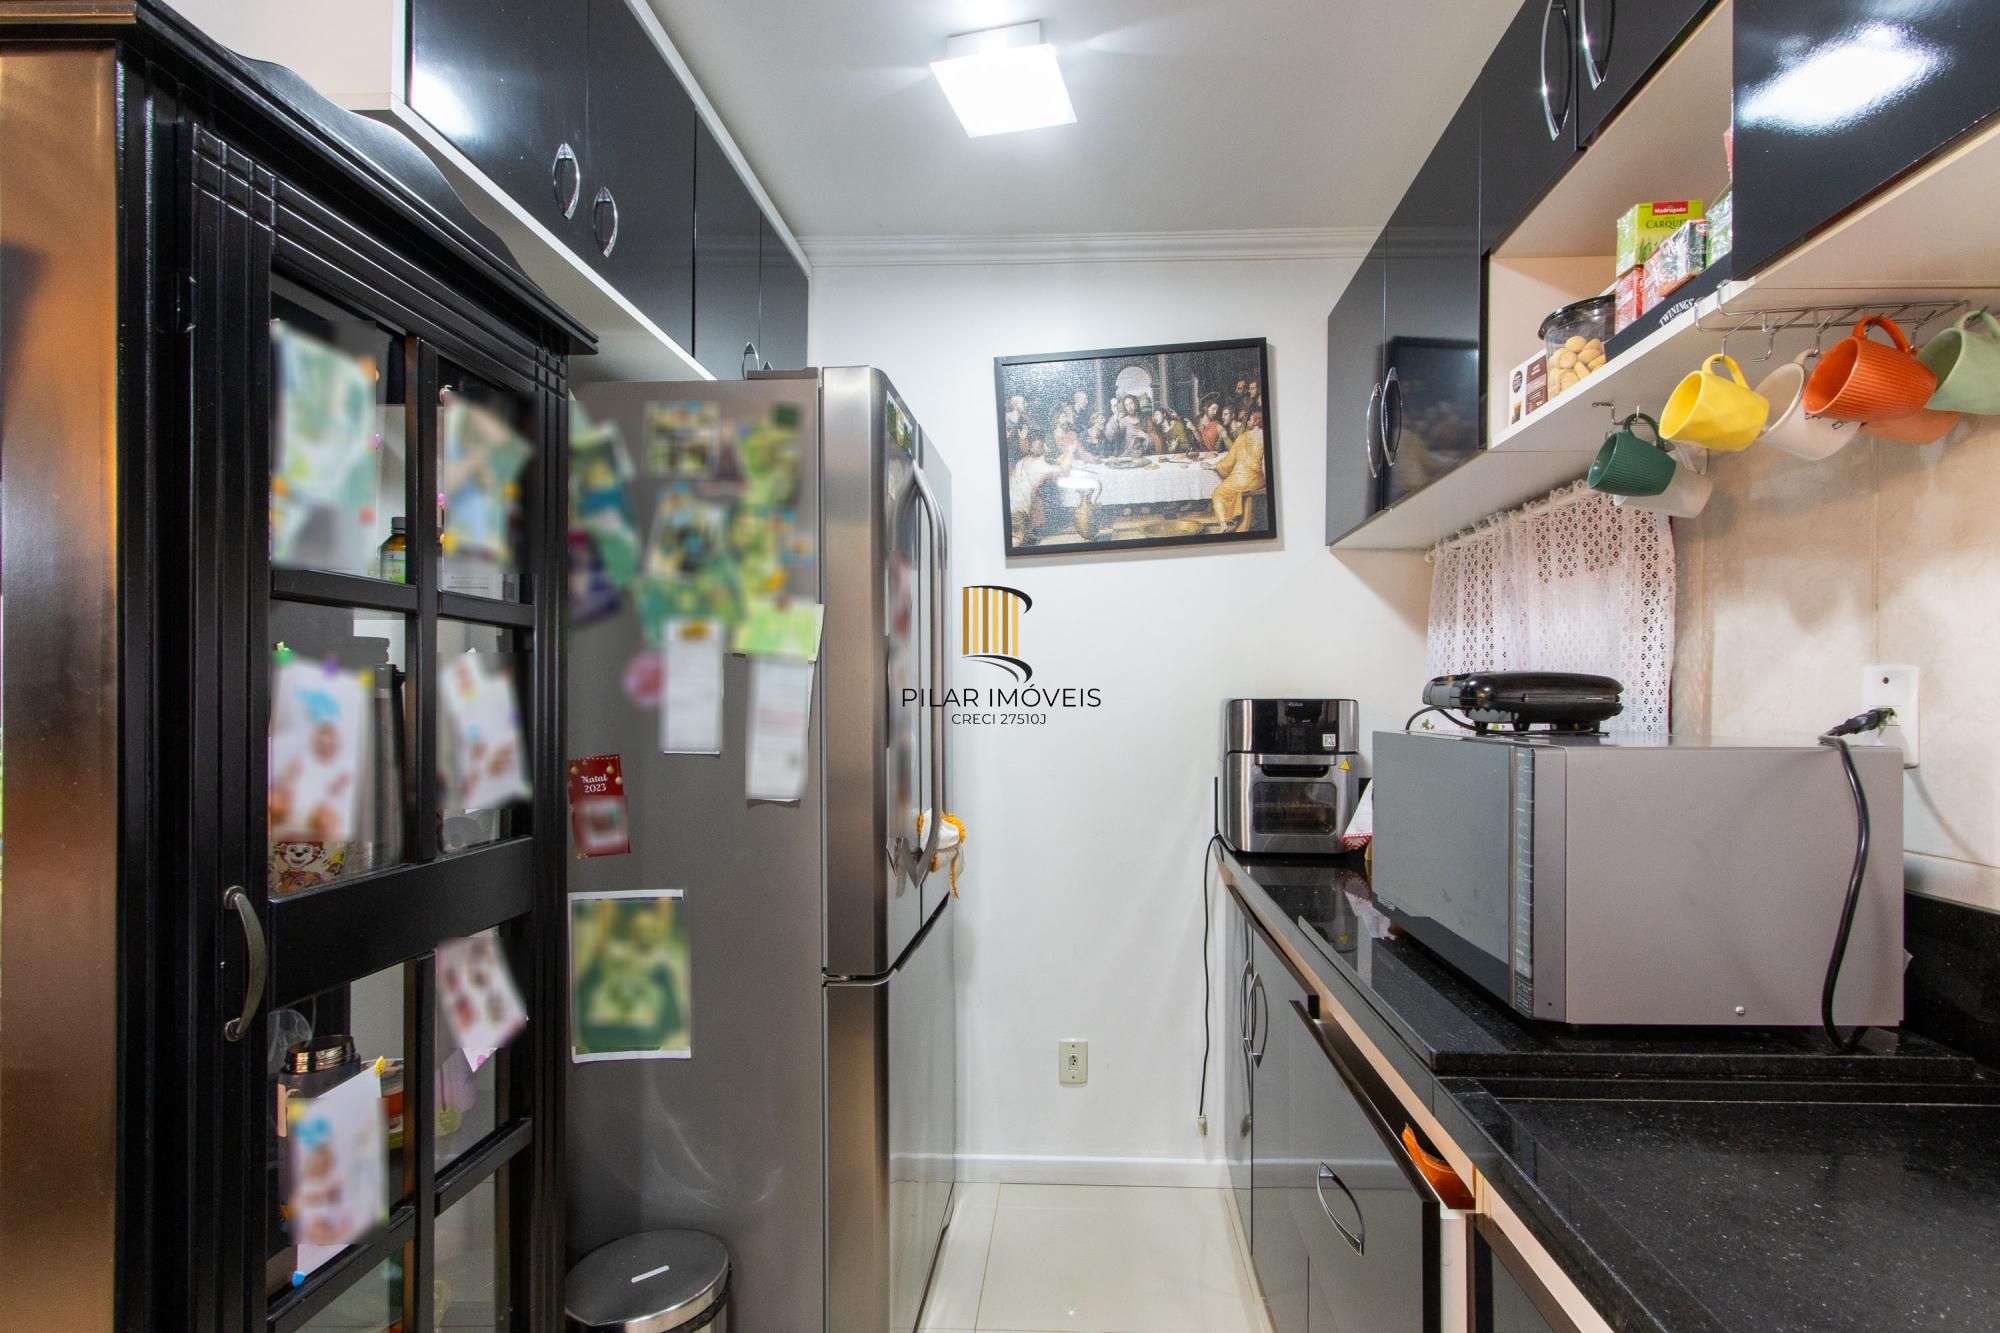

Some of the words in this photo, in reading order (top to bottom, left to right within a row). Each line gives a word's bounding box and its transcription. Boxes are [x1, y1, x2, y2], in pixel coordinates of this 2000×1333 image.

[1646, 219, 1687, 230] CARQUE
[1658, 298, 1695, 327] TWININGS
[581, 774, 608, 783] Natal
[585, 783, 606, 793] 2023
